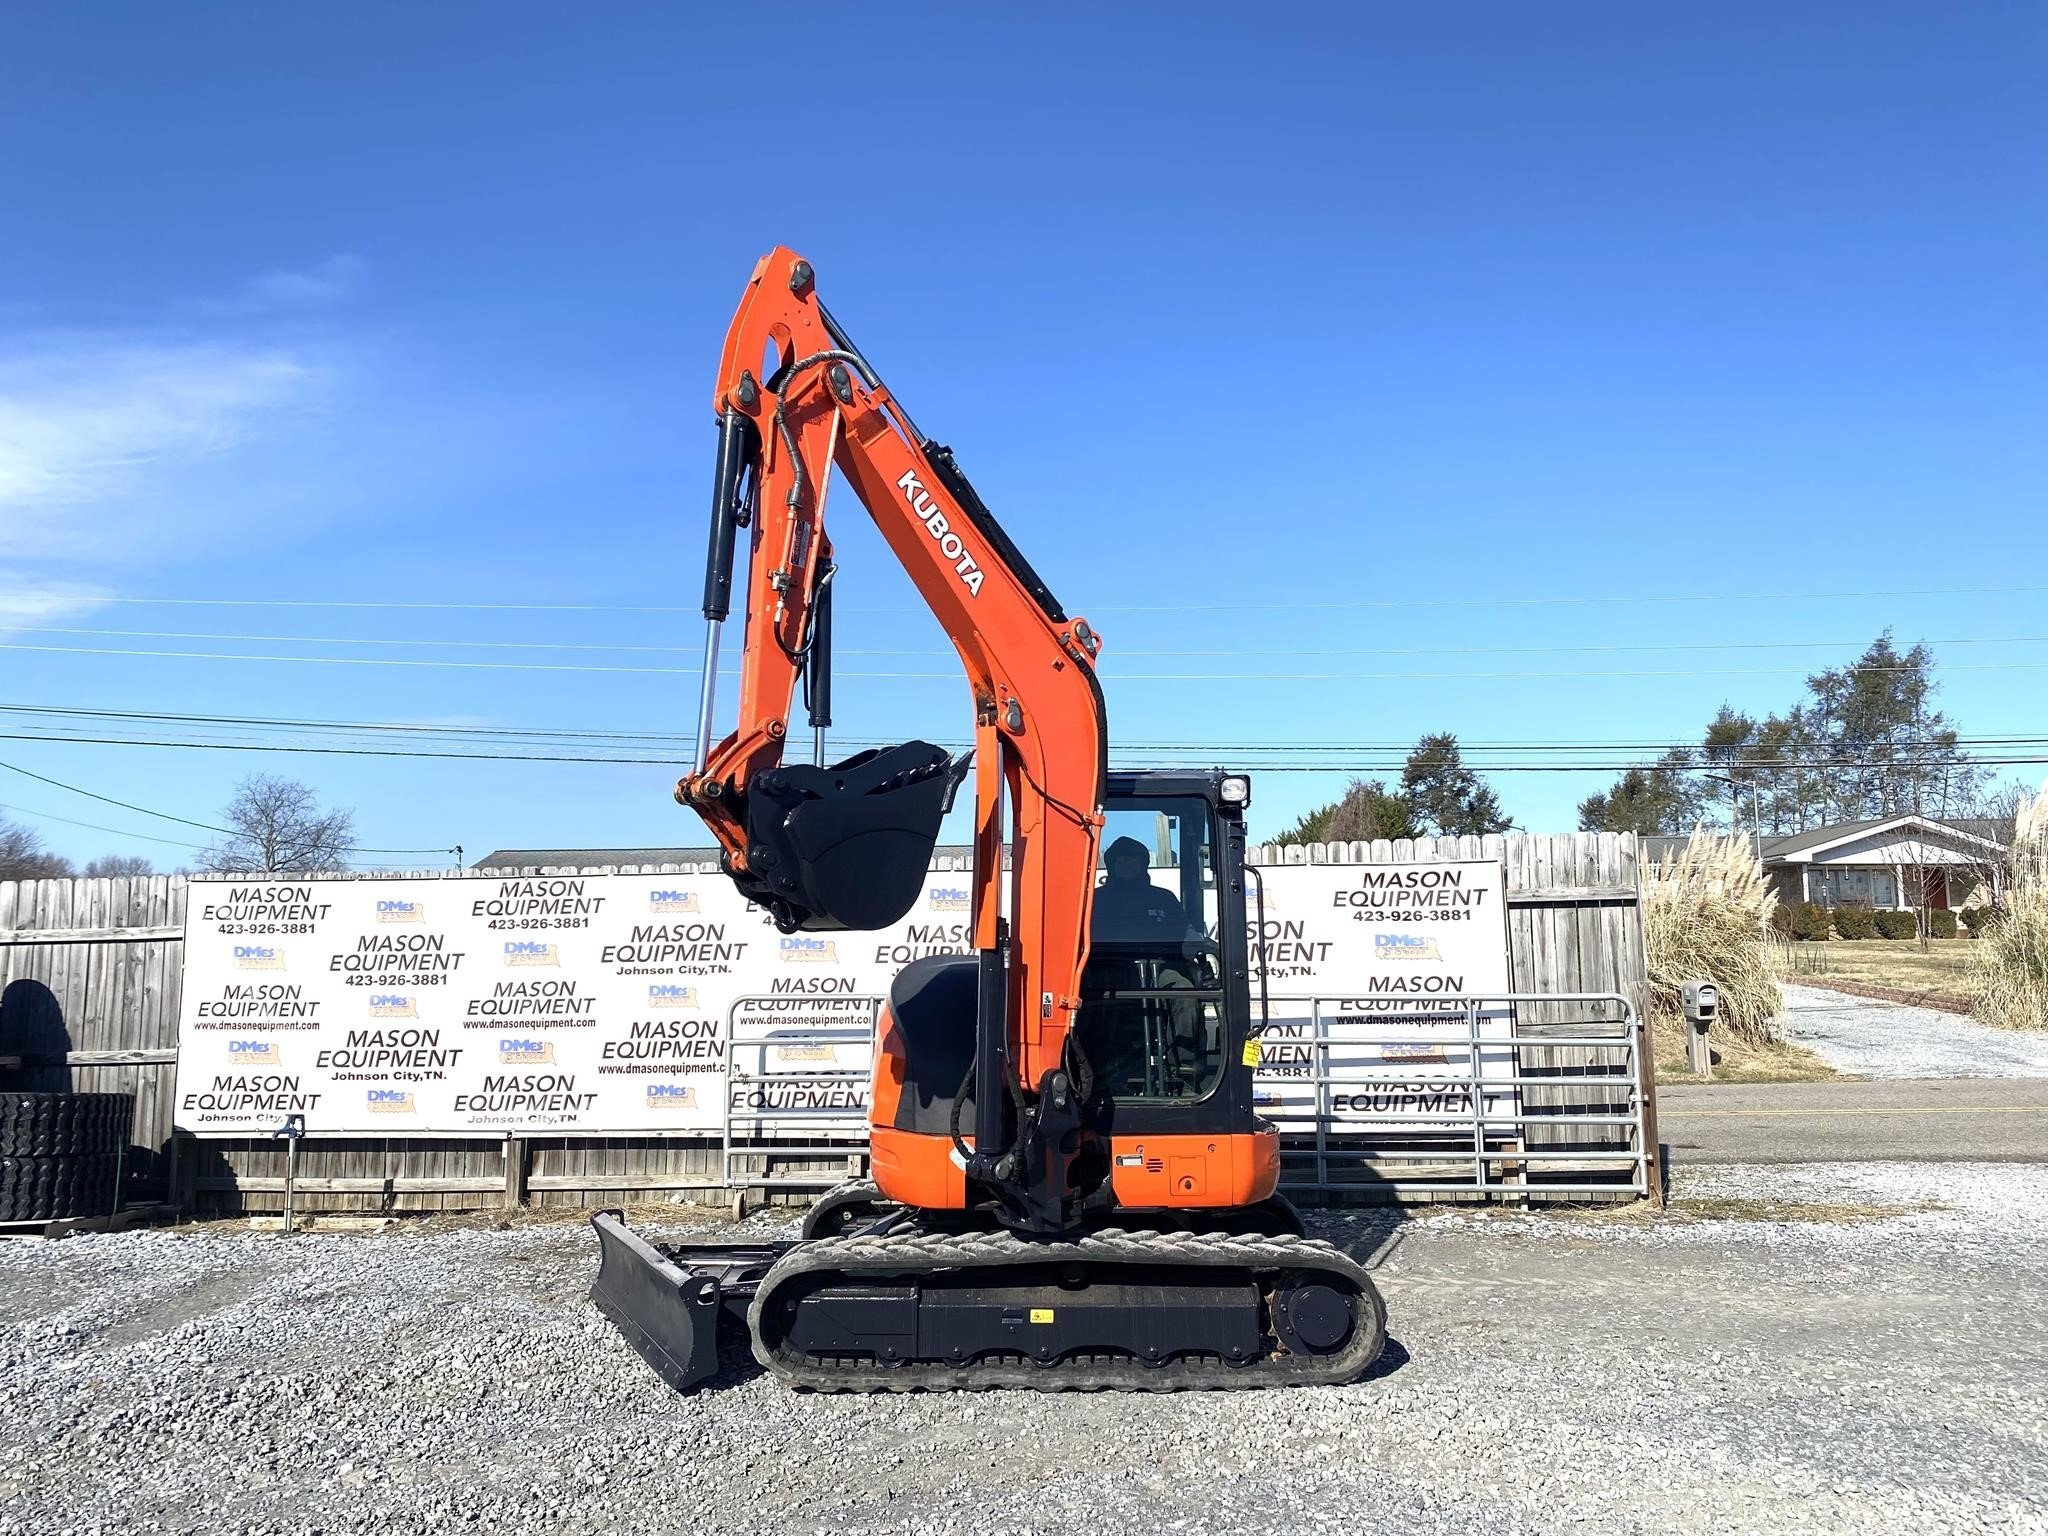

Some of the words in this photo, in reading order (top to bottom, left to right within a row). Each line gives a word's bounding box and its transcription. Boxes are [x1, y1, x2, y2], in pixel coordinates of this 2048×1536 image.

[897, 469, 986, 598] KUBOTA
[1363, 871, 1461, 888] MASON
[229, 888, 311, 903] MASON
[500, 881, 584, 897] MASON
[1334, 889, 1488, 907] EQUIPMENT
[203, 905, 331, 920] EQUIPMENT
[472, 898, 605, 916] EQUIPMENT
[488, 918, 588, 929] 423-926-3881
[1353, 910, 1470, 921] 423-926-3881
[219, 924, 314, 934] 423-926-3881
[631, 924, 724, 942] MASON
[358, 935, 444, 951] MASON
[601, 944, 748, 962] EQUIPMENT
[330, 954, 465, 971] EQUIPMENT
[617, 967, 673, 975] Johnson
[679, 965, 731, 975] City,TN.
[346, 974, 446, 985] 423-926-3881
[771, 978, 855, 993] MASON
[1369, 976, 1463, 992] MASON
[224, 985, 301, 1000] MASON
[494, 981, 576, 997] MASON
[198, 1002, 320, 1016] EQUIPMENT
[468, 998, 596, 1015] EQUIPMENT
[195, 1021, 319, 1032] www.dmasonequipment.com
[463, 1018, 595, 1030] www.dmasonequipment.com
[740, 1014, 870, 1026] www.dmasonequipment.co
[1336, 1014, 1491, 1027] www.dmasonequipment.om
[630, 1021, 718, 1038] MASON
[347, 1030, 440, 1047] MASON
[602, 1040, 725, 1058] EQUIPMEN
[316, 1050, 463, 1067] EQUIPMENT
[332, 1072, 388, 1080] Johnson
[394, 1071, 446, 1082] City,TN.
[598, 1062, 740, 1076] www.dmasonequipment.cm
[213, 1076, 299, 1092] MASON
[483, 1075, 575, 1092] MASON
[183, 1094, 321, 1110] EQUIPMENT
[454, 1094, 597, 1111] EQUIPMENT
[1334, 1094, 1500, 1112] EQUIPMENT
[198, 1114, 251, 1122] Johnson
[468, 1116, 523, 1124] Johnson
